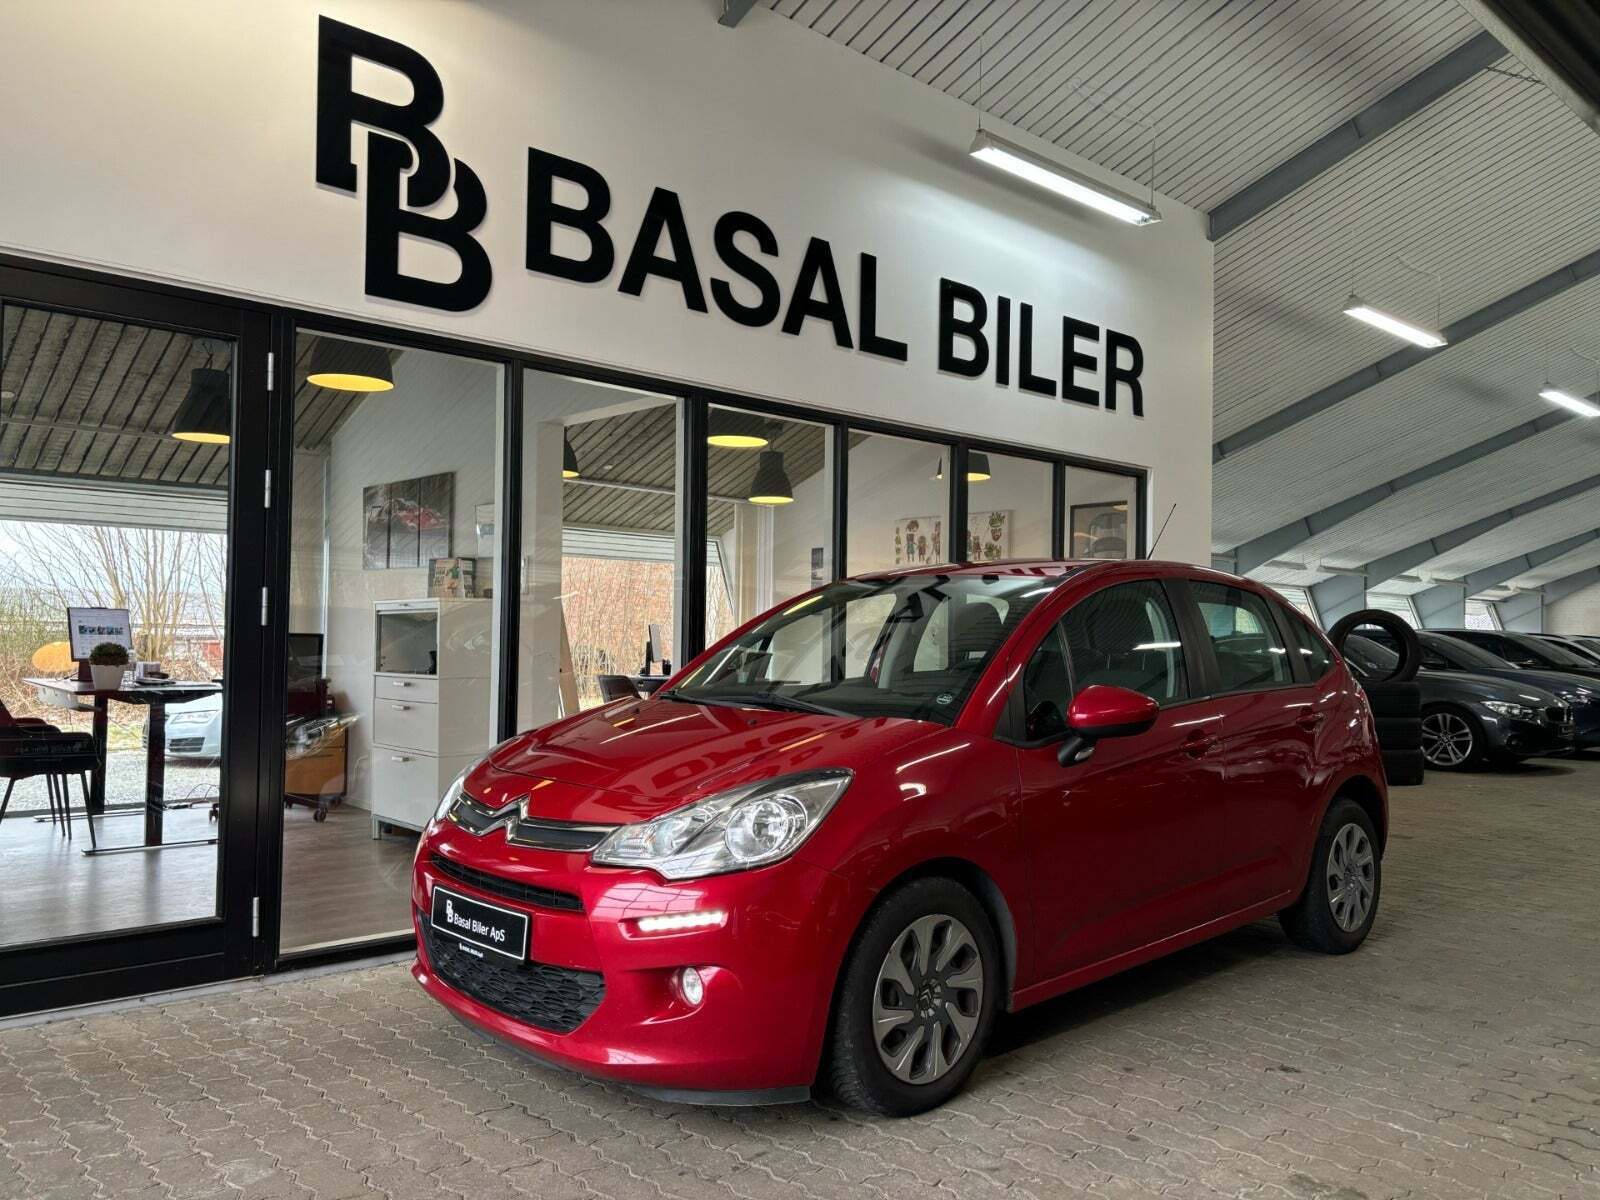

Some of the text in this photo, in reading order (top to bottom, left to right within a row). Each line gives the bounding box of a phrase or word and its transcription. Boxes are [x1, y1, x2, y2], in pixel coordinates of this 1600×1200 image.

[526, 147, 1143, 416] BASAL BILER
[454, 913, 471, 930] Basal
[472, 920, 490, 936] Biler
[490, 927, 506, 942] ApS
